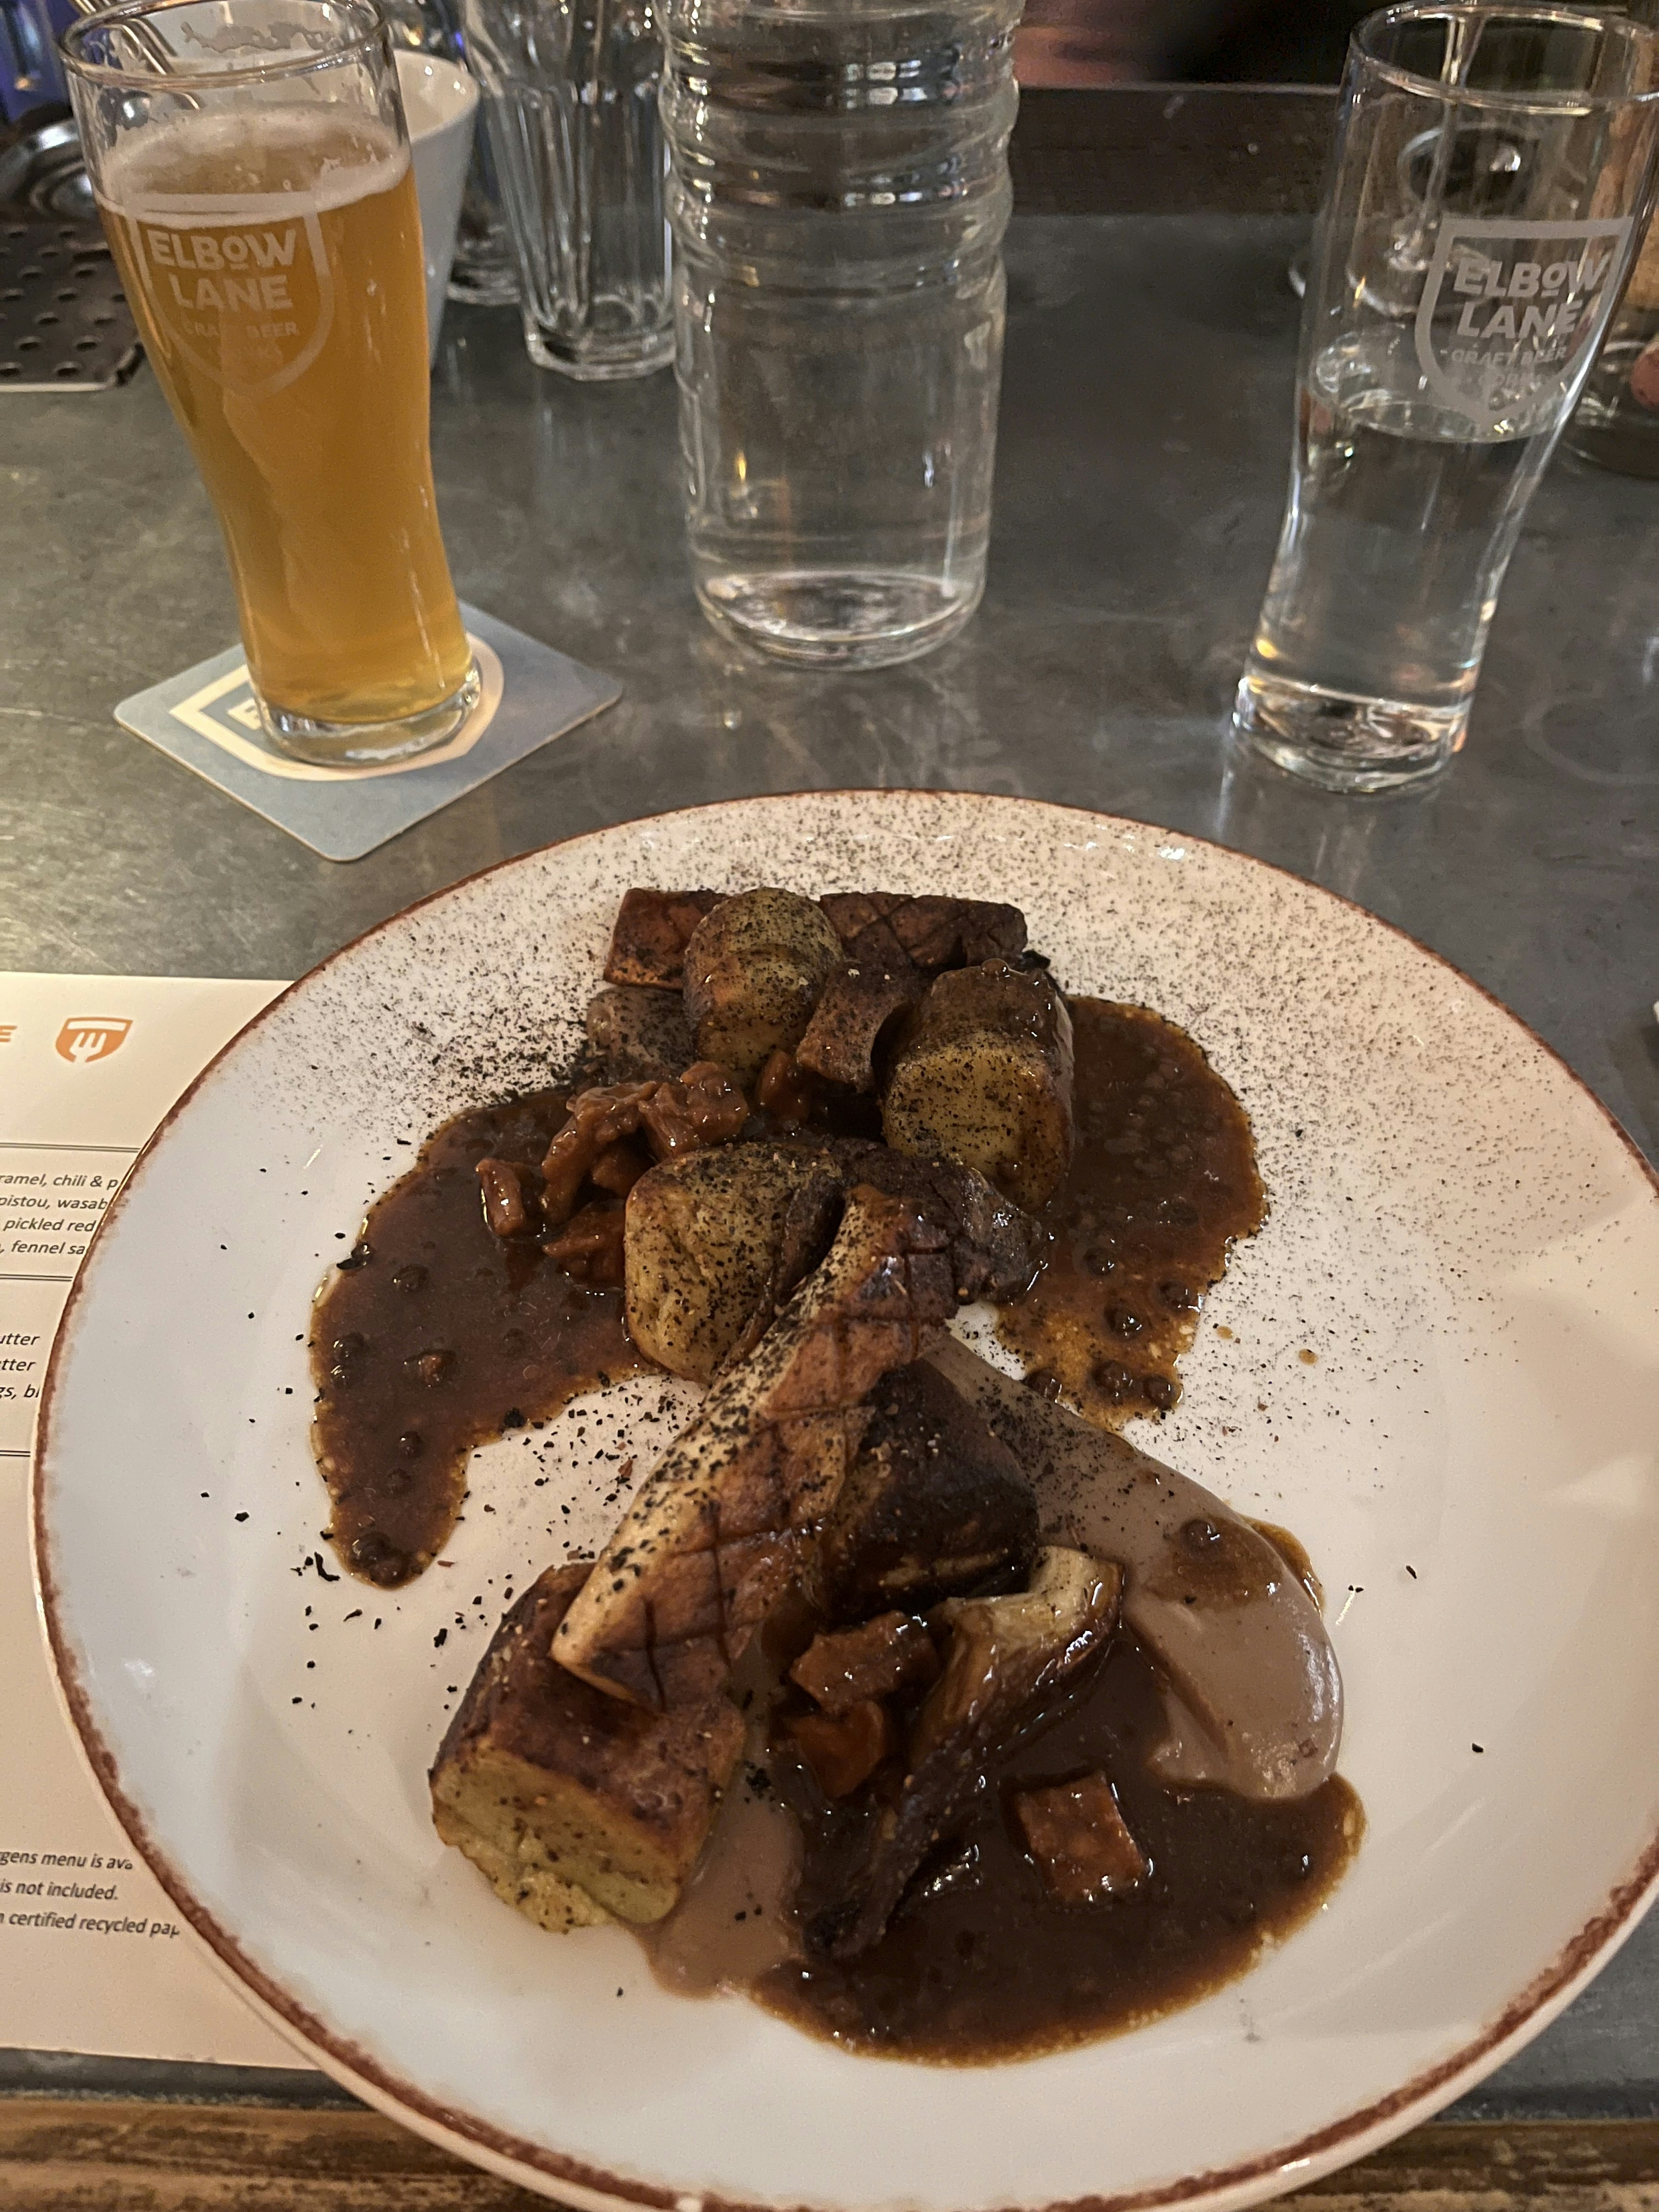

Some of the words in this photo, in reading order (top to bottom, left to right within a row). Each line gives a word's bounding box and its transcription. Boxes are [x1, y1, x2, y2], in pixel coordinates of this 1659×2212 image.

[169, 274, 294, 312] LANE
[1456, 299, 1584, 339] LANE
[53, 1175, 88, 1187] chili
[90, 1176, 102, 1187] &
[3, 1217, 65, 1231] pickled
[67, 1220, 96, 1232] red
[11, 1240, 66, 1254] fennel
[42, 1853, 87, 1868] menu
[91, 1853, 103, 1869] is
[16, 1881, 44, 1896] not
[47, 1882, 119, 1901] included.
[9, 1912, 77, 1929] certified
[79, 1917, 148, 1935] recycled
